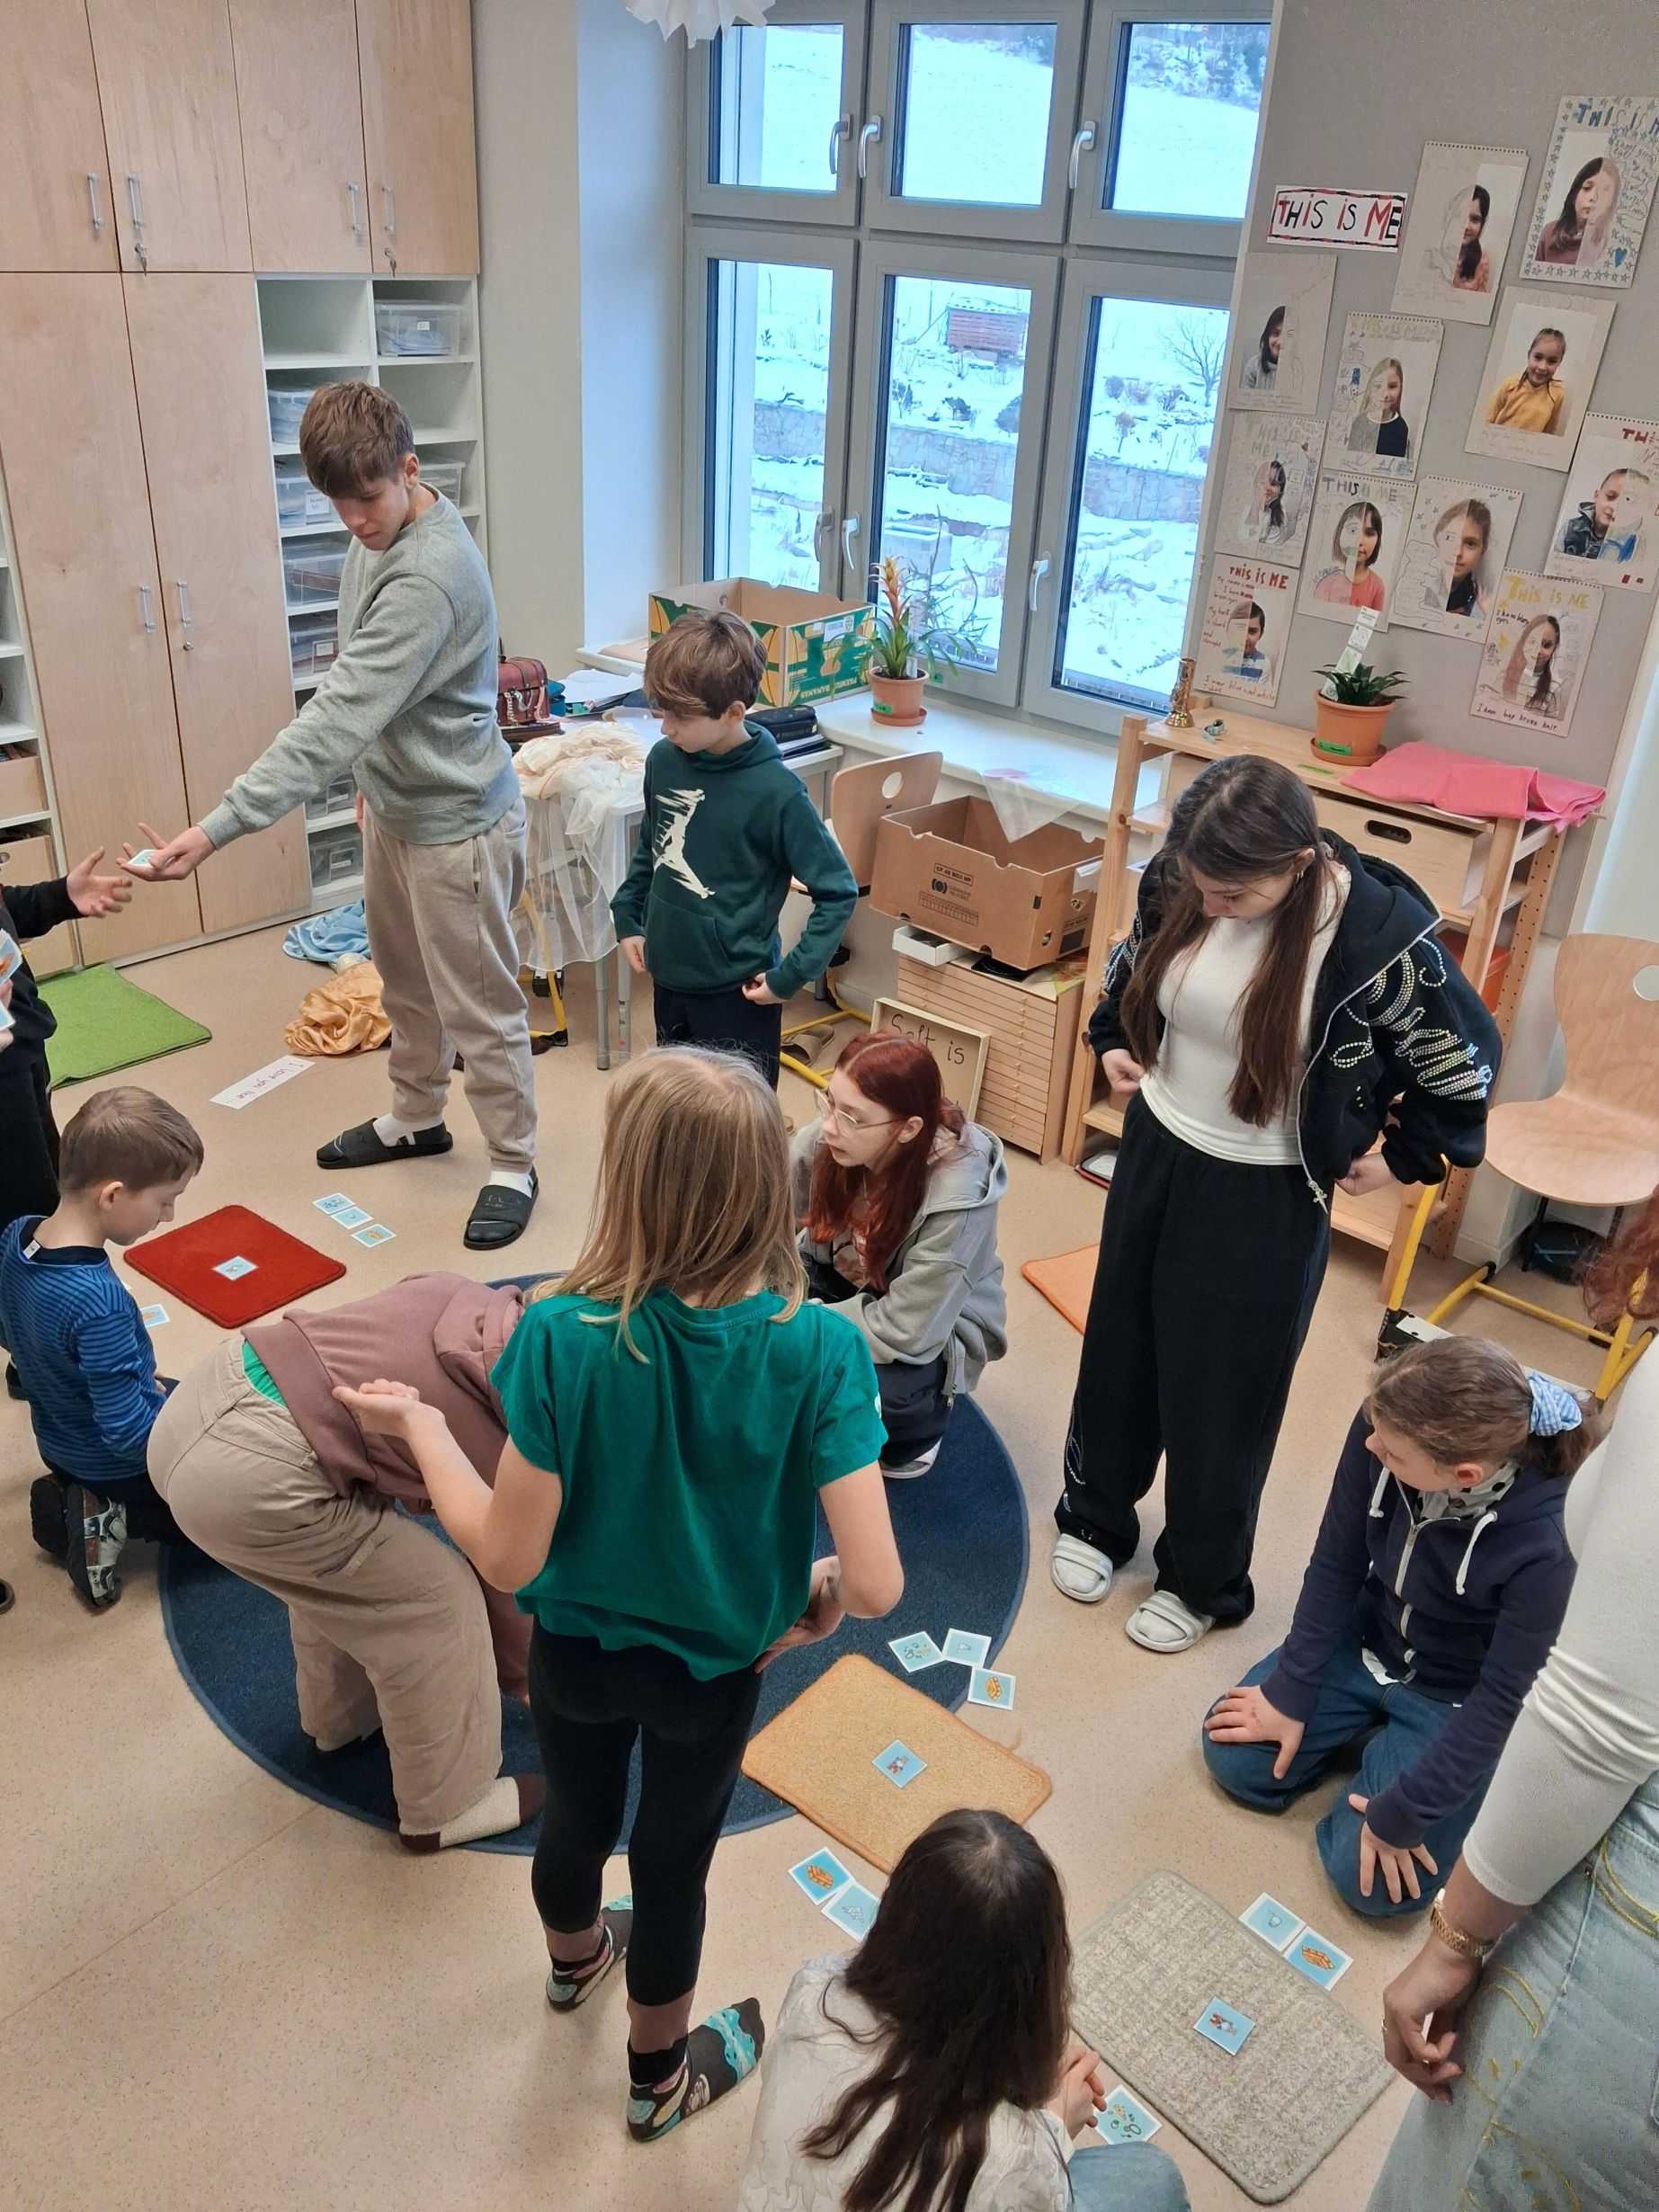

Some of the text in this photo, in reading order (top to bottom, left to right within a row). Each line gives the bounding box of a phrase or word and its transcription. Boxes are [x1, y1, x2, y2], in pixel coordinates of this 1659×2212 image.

[1364, 201, 1403, 240] ME
[1323, 477, 1360, 496] THIS
[1269, 572, 1289, 590] ME
[1568, 593, 1590, 609] ME
[948, 1039, 964, 1065] is
